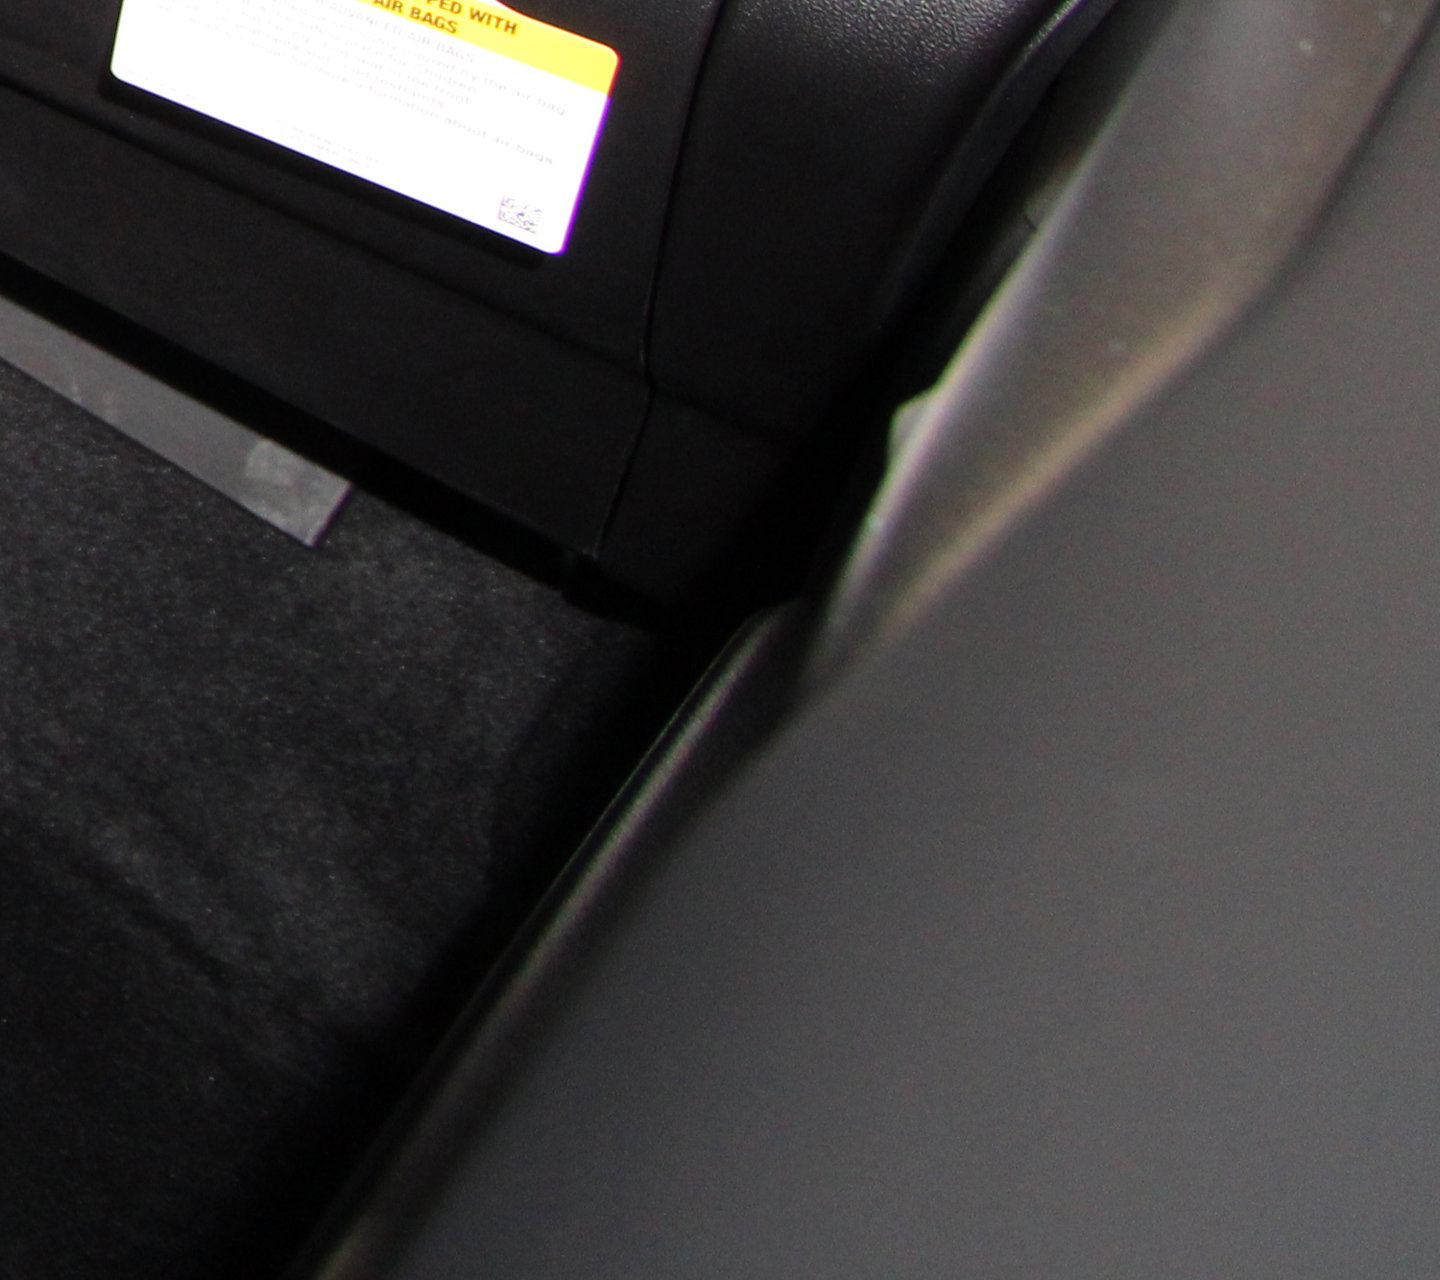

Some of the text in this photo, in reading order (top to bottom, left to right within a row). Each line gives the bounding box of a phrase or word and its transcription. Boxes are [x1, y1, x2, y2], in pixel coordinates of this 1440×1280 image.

[409, 7, 459, 35] BAGS
[469, 7, 518, 36] WITH
[406, 31, 432, 47] AIR
[435, 42, 476, 65] BAGS
[482, 77, 508, 93] the
[512, 89, 531, 102] air
[442, 113, 489, 139] about
[491, 133, 512, 148] air
[513, 142, 555, 167] bags
